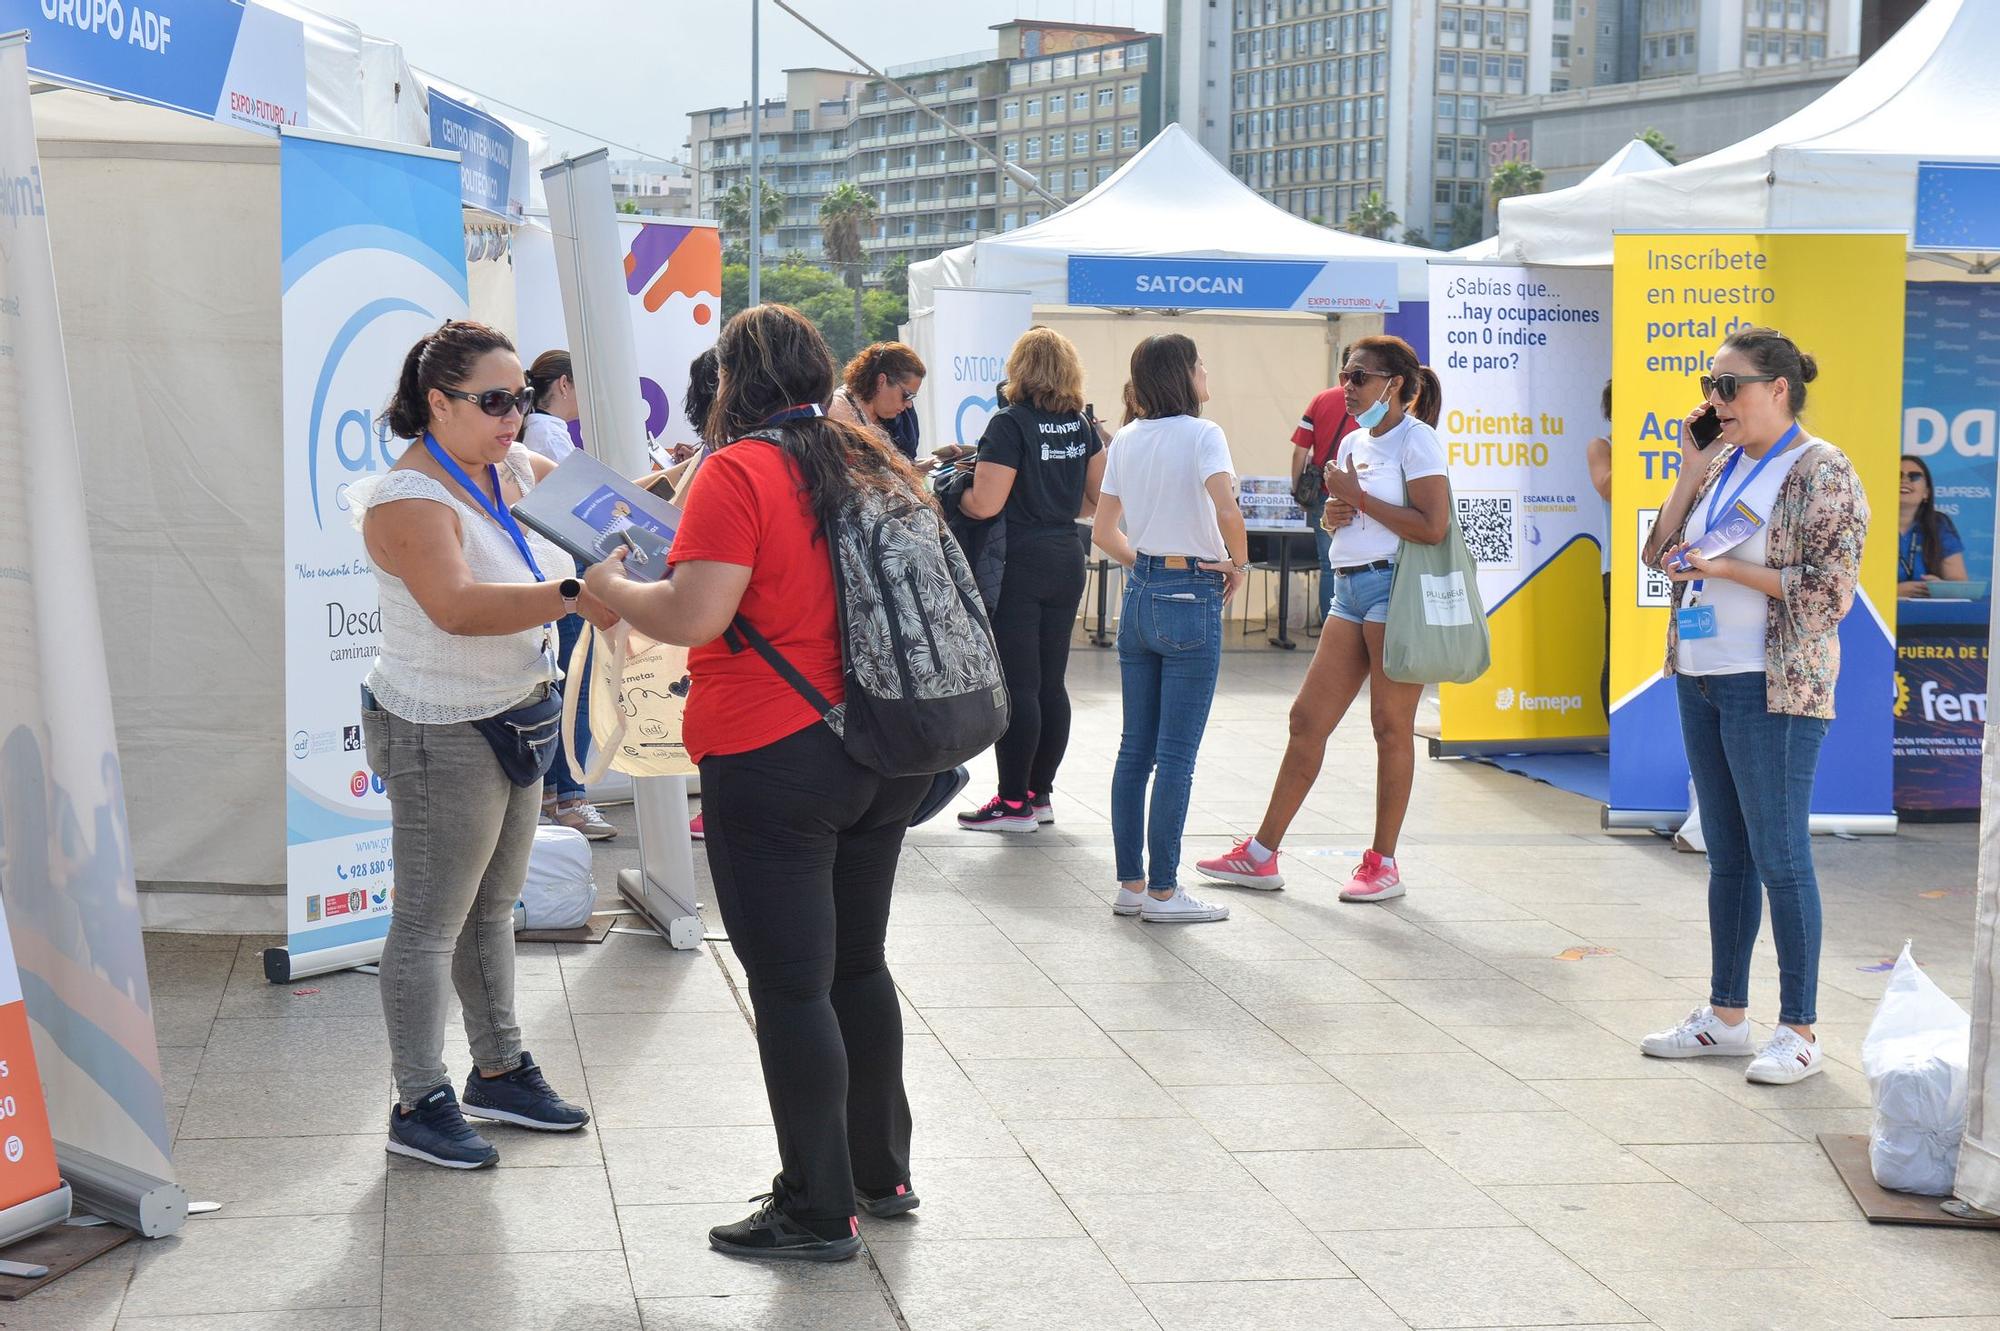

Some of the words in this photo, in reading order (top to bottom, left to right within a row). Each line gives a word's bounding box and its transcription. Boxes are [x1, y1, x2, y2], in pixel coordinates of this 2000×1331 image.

[128, 7, 171, 55] ADF
[231, 92, 251, 114] EXPO
[256, 100, 285, 125] FUTURO
[442, 118, 469, 150] CENTRO
[1648, 248, 1767, 270] Inscríbete
[1135, 275, 1244, 295] SATOCAN
[1447, 277, 1512, 299] ¿Sabías
[1516, 283, 1561, 300] que...
[1647, 287, 1675, 304] en
[1684, 285, 1775, 304] nuestro
[1337, 298, 1370, 306] FUTURO
[1447, 302, 1493, 324] ...hay
[1497, 304, 1600, 325] ocupaciones
[1447, 331, 1478, 344] con
[1482, 328, 1493, 344] 0
[1497, 328, 1547, 346] índice
[1647, 316, 1716, 343] portal
[1448, 351, 1468, 369] de
[1473, 353, 1519, 374] paro?
[1447, 409, 1534, 435] Orienta
[1540, 413, 1564, 436] tu
[1448, 442, 1549, 467] FUTURO
[1639, 451, 1682, 479] TR
[1523, 495, 1555, 503] ESCANEA
[318, 564, 350, 577] encanta
[1898, 646, 1955, 659] FUERZA
[1959, 646, 1977, 659] DE
[627, 673, 655, 683] metas
[1519, 691, 1582, 715] femepa
[350, 864, 368, 878] 928
[369, 860, 386, 875] 880
